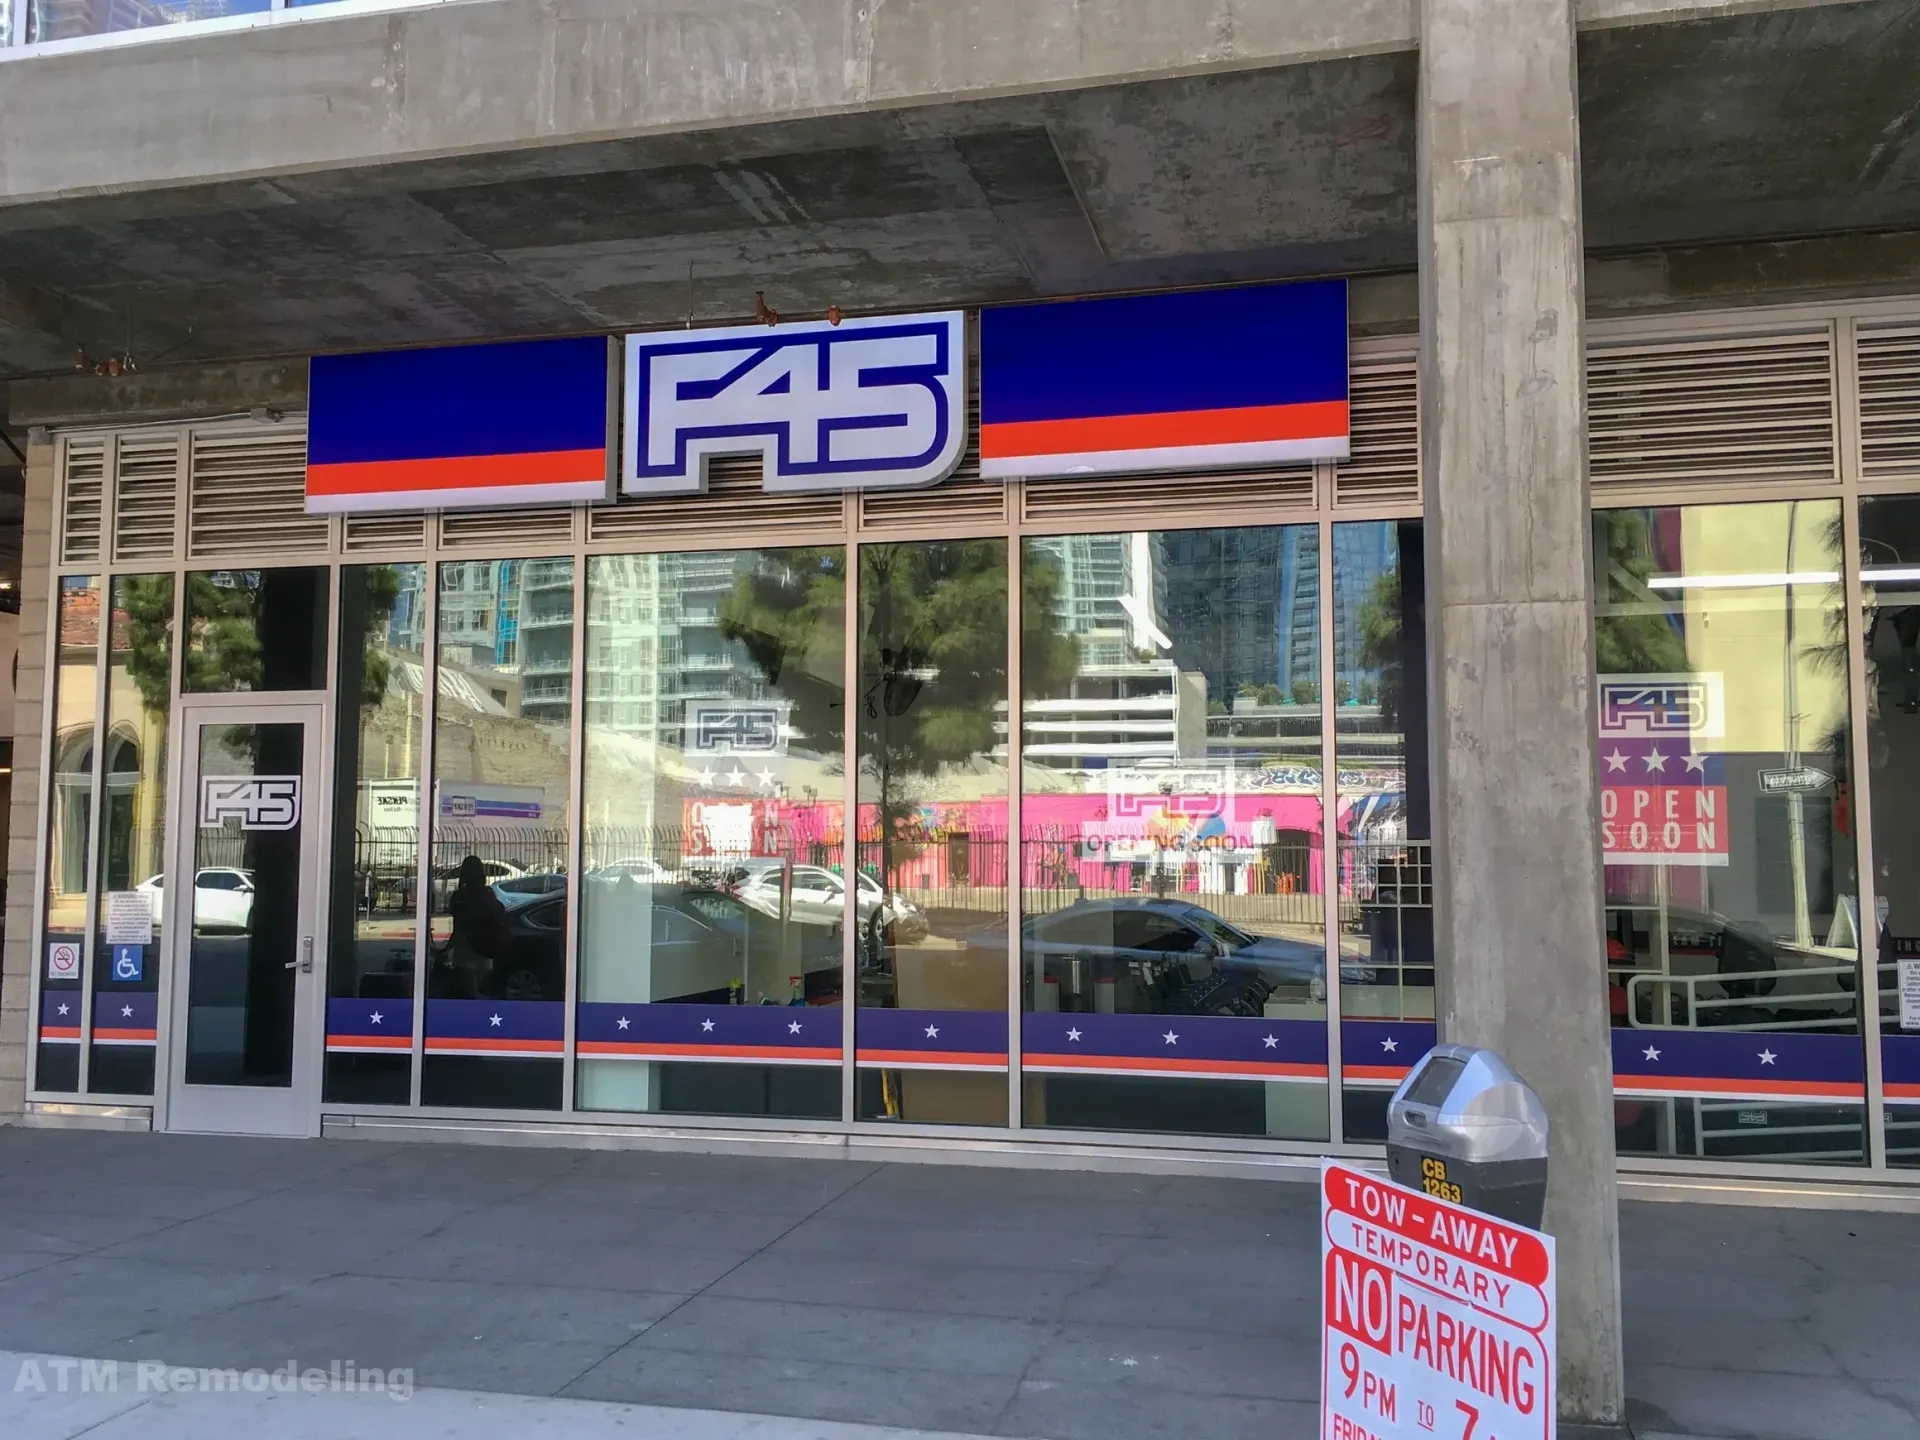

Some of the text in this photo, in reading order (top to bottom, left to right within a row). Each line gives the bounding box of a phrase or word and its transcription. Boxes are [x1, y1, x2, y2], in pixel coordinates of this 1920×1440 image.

[637, 320, 949, 478] F45
[1600, 682, 1708, 731] F45
[696, 709, 778, 751] F45
[201, 776, 300, 830] F45
[692, 801, 779, 827] ON
[1601, 789, 1715, 819] OPEN
[691, 829, 777, 854] SN
[1192, 834, 1254, 852] SOON
[1602, 821, 1715, 850] SOON
[1423, 1158, 1446, 1181] CB
[1423, 1177, 1462, 1204] 1263
[1352, 1222, 1511, 1309] TEMPORARY
[1335, 1253, 1534, 1415] NO PARKING
[1417, 1400, 1434, 1427] TO
